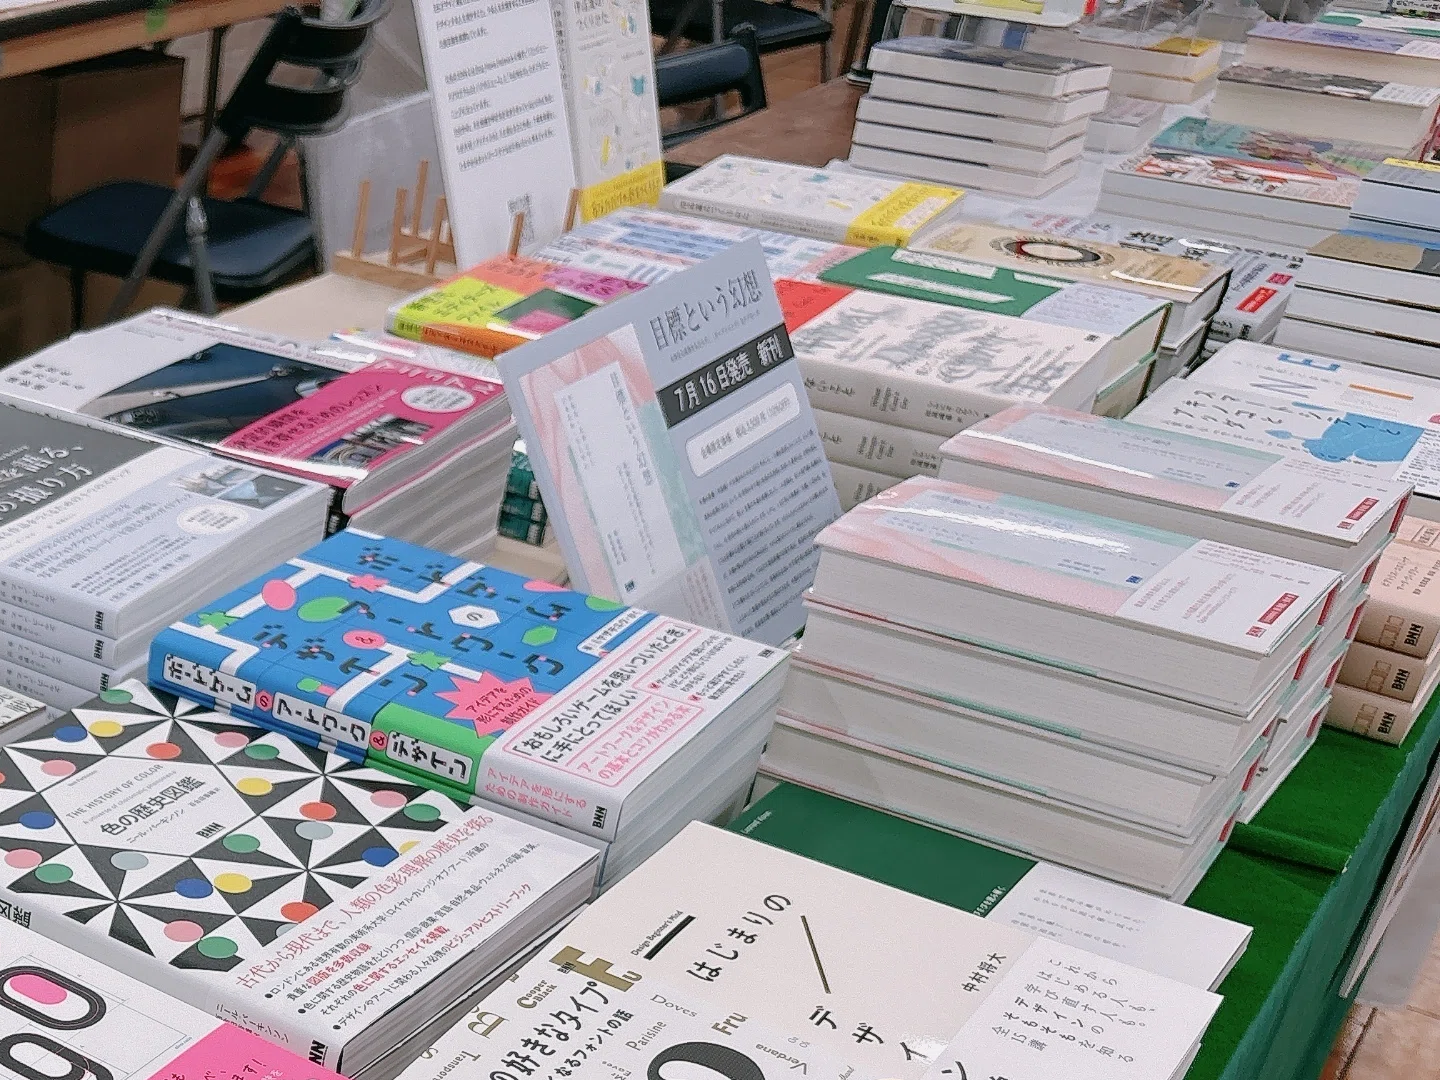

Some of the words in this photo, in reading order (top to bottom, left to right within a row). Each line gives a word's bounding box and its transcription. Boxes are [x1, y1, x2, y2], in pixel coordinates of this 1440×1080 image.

[649, 269, 763, 351] 目標という幻想
[512, 624, 693, 756] 「おもしろいゲームを思いついたとき」
[539, 688, 639, 764] に手にとってほしい
[576, 699, 670, 774] アートワーク&デザイン
[597, 705, 691, 780] の基本とコツがわかる本
[390, 732, 469, 781] デザイン
[66, 806, 86, 821] THE
[88, 785, 124, 811] HISTORY
[123, 778, 136, 790] OF
[134, 764, 164, 783] COLOR
[99, 775, 206, 837] 色の歴史図鑑
[486, 765, 589, 811] アイデアを形にする
[592, 805, 608, 829] BNN
[235, 814, 495, 991] 古代から現代まで、人類の色彩理解の歴史を探る
[686, 893, 792, 984] はじまりの
[286, 942, 373, 1002] 貴重な図版を多数収録
[320, 926, 452, 1017] それぞれの色に関するエッセイを掲載
[961, 952, 1007, 993] 中村将大
[1037, 970, 1157, 1013] はじめる人も、
[1048, 957, 1119, 987] これから
[649, 993, 698, 1018] Doves
[1014, 996, 1105, 1035] デザインの
[1024, 983, 1147, 1028] 学び直す人も。
[625, 1019, 667, 1053] Parisine
[1002, 1011, 1135, 1064] そもそもを知る
